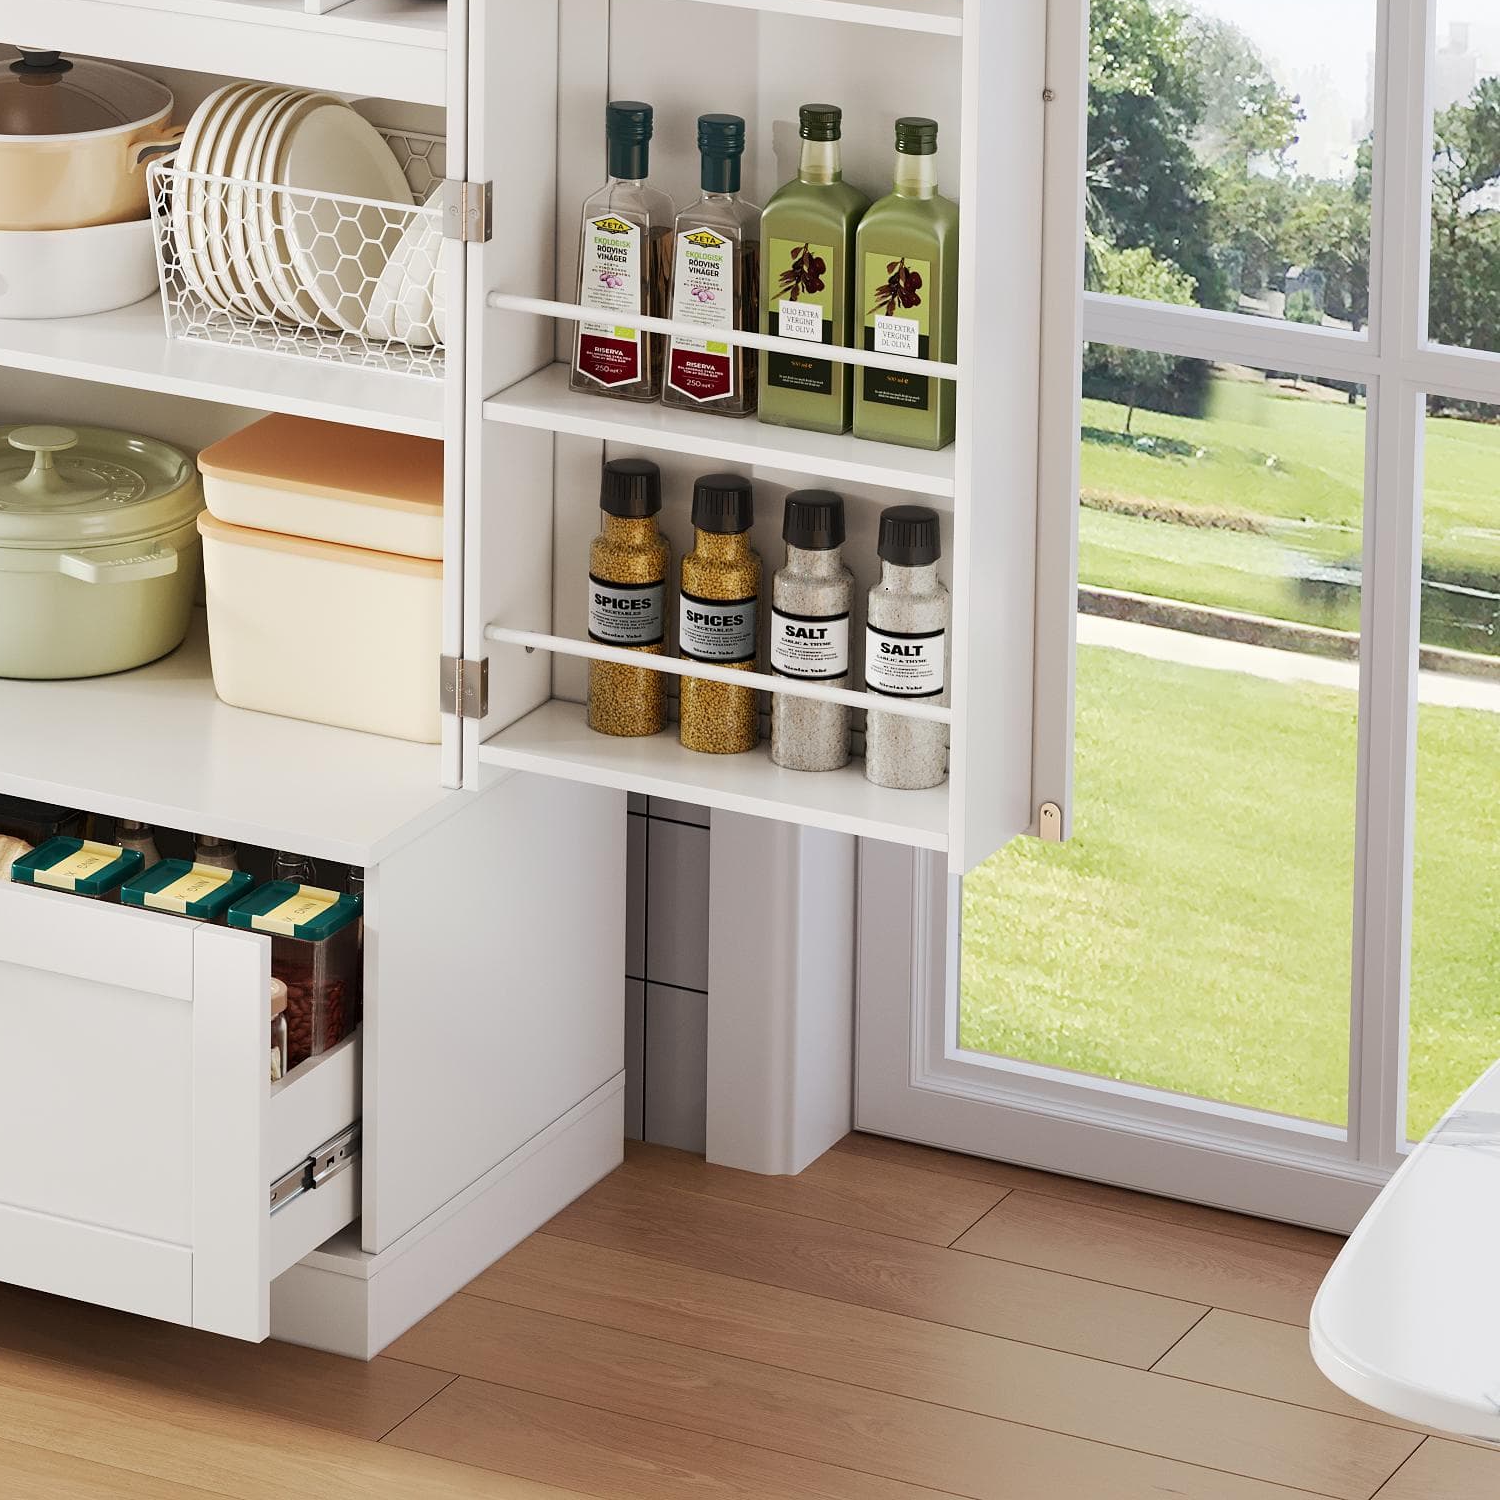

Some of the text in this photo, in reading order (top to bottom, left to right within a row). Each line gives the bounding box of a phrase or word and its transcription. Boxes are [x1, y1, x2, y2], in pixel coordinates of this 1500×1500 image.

[601, 220, 624, 230] ZETA
[594, 236, 632, 249] EKOLOGISK
[693, 235, 716, 244] ZETA
[596, 244, 628, 256] RÖDVINS
[685, 250, 724, 262] EKOLOGISK
[596, 252, 627, 264] VINÄGER
[688, 258, 720, 270] RÖDVINS
[688, 266, 720, 278] VINÄGER
[782, 306, 819, 318] OLIO EXTRA
[786, 316, 814, 327] VERGINE
[878, 321, 916, 334] OLIO EXTRA
[794, 326, 815, 335] OLIVA
[882, 330, 911, 342] VERGINE
[890, 340, 912, 350] OLIVA
[594, 346, 624, 357] RISERVA
[686, 360, 716, 372] RISERVA
[594, 592, 652, 610] SPICES
[602, 608, 642, 616] VEGETABLES
[686, 609, 744, 626] SPICES
[785, 625, 828, 640] SALT
[782, 637, 802, 646] GARLIC
[880, 642, 924, 657] SALT
